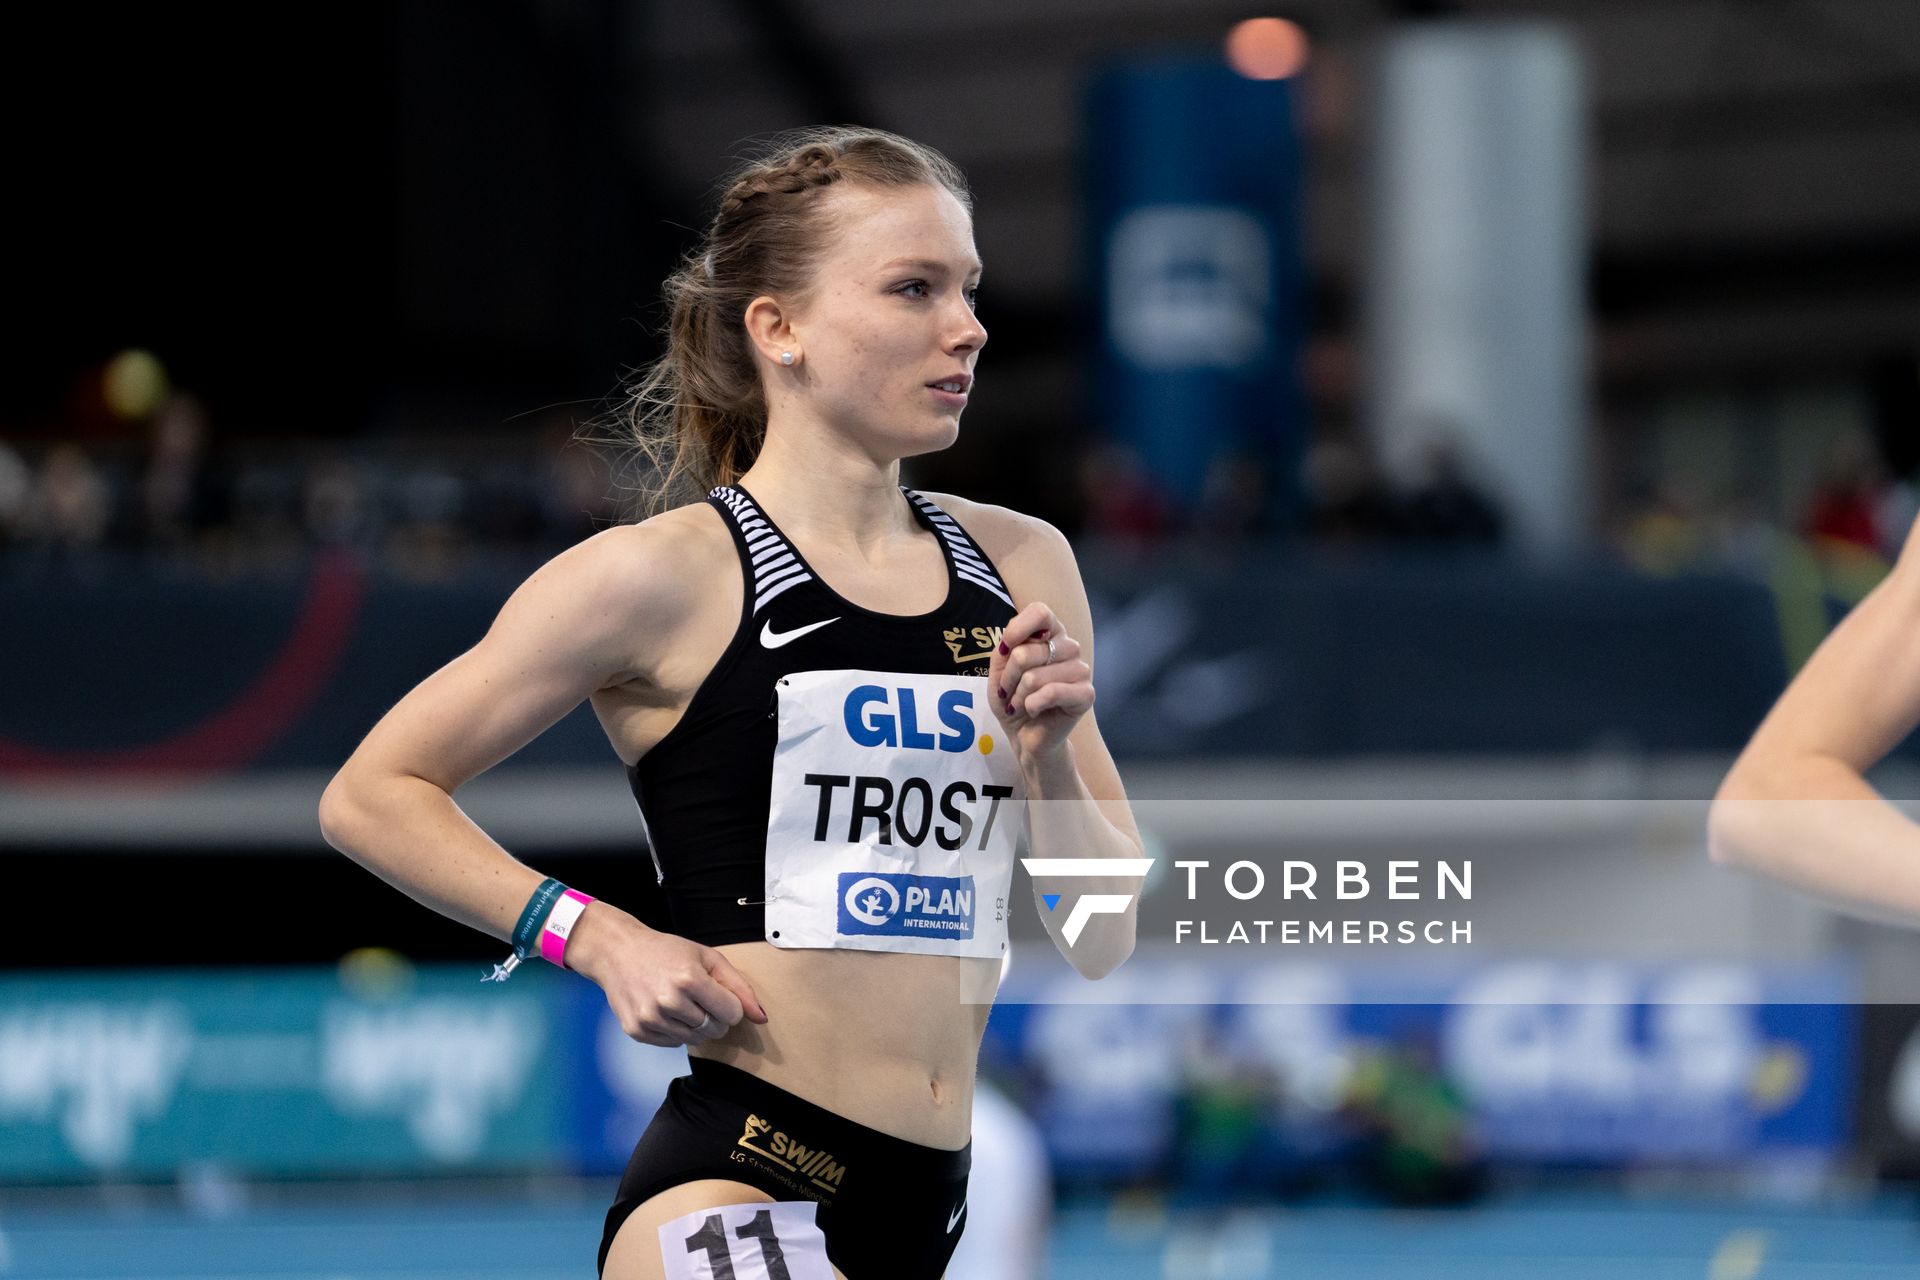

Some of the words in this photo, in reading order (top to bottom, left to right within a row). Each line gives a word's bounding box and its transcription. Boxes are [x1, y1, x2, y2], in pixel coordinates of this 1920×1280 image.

[804, 773, 1014, 851] TROST
[904, 886, 972, 917] PLAN
[995, 896, 1004, 923] 84
[903, 918, 970, 931] INTERNATIONAL
[730, 1150, 746, 1163] LG
[684, 1209, 792, 1280] 11
